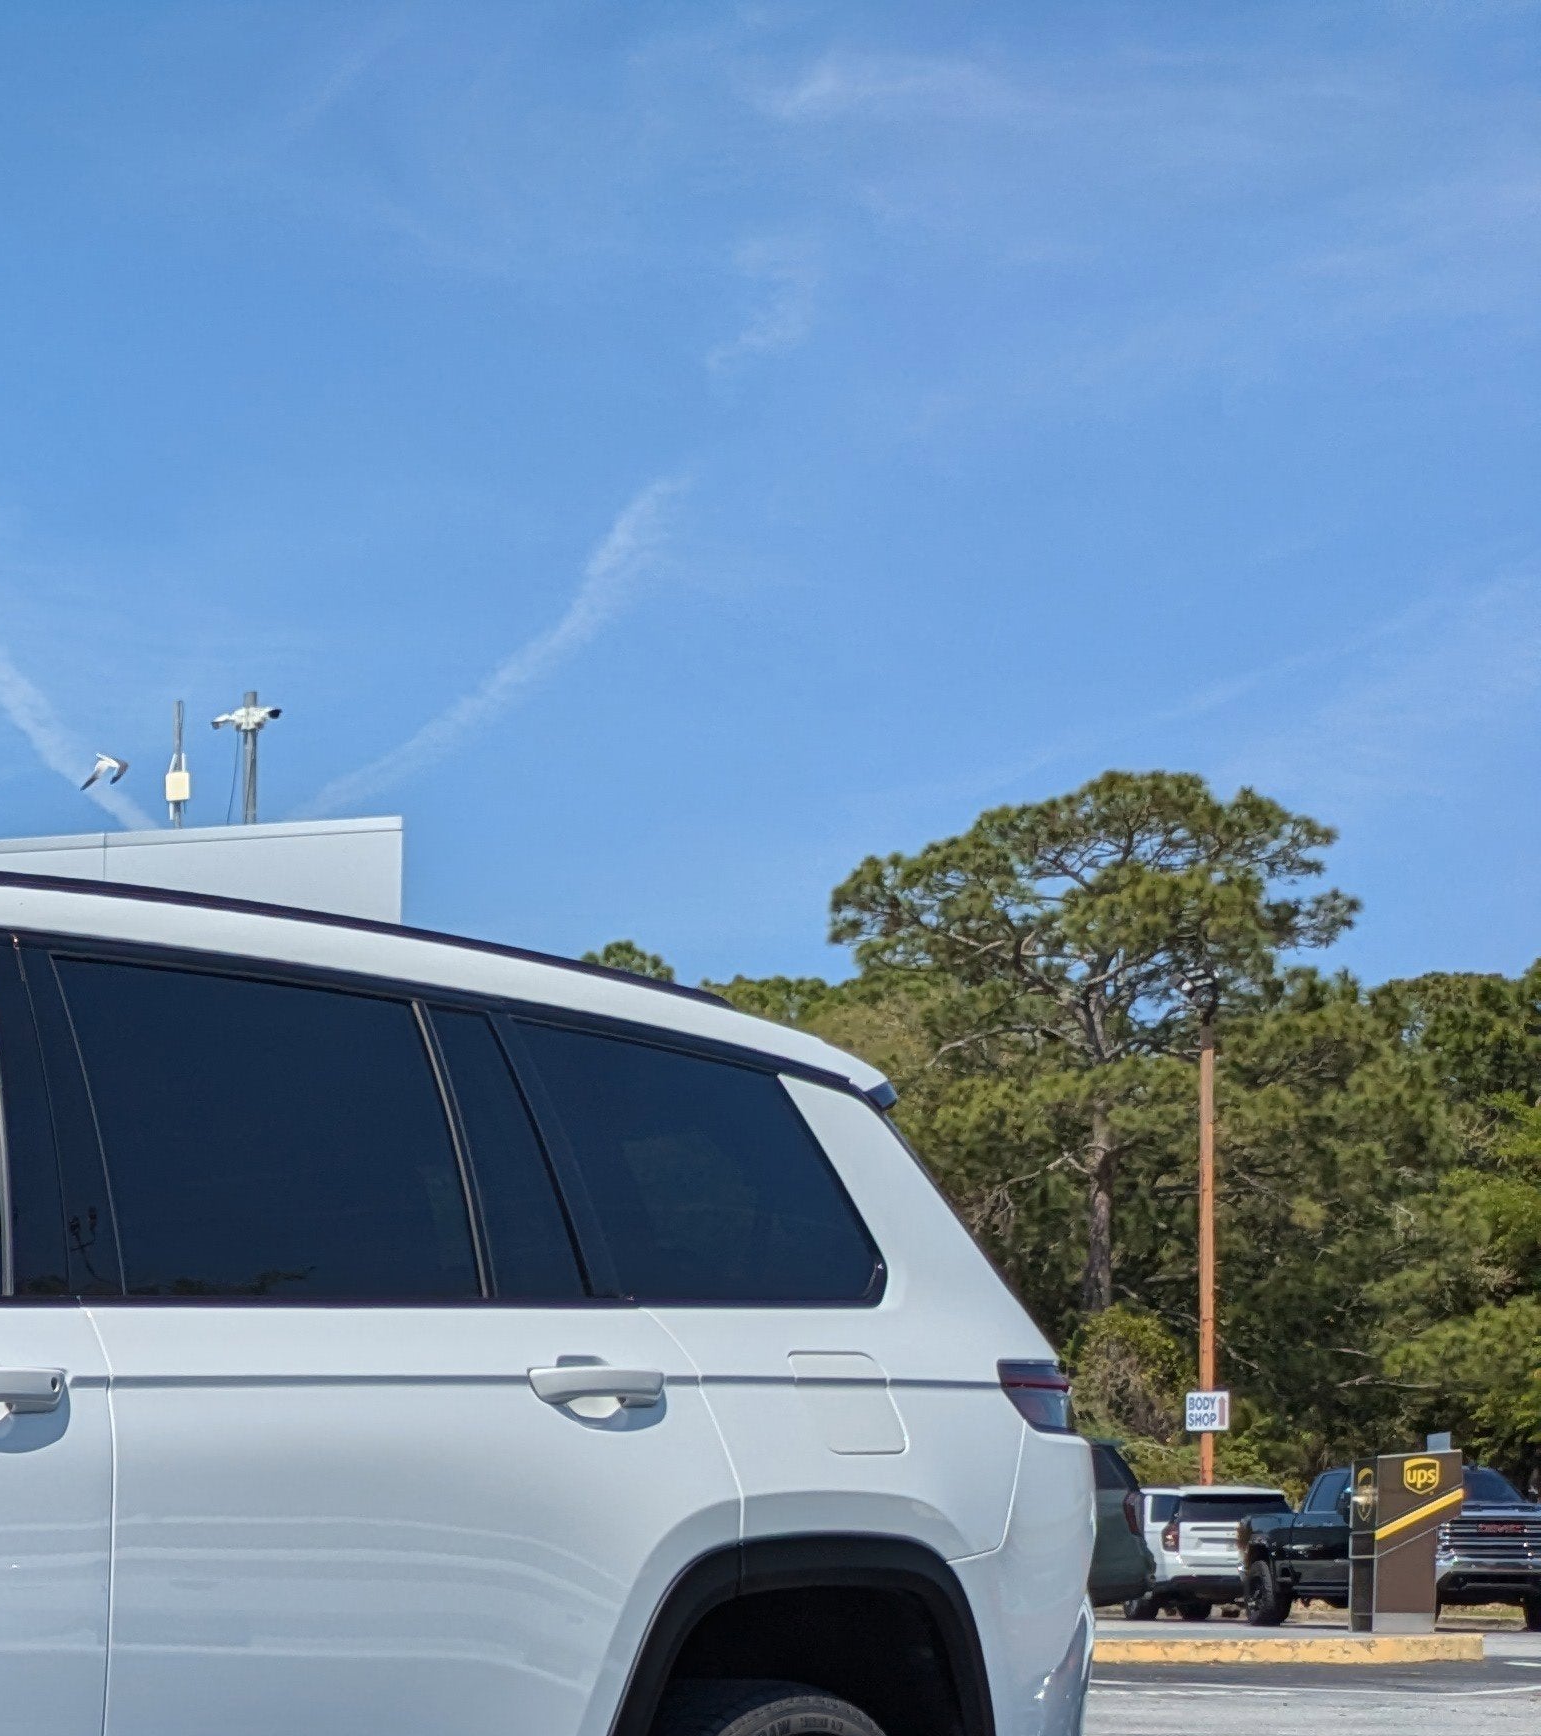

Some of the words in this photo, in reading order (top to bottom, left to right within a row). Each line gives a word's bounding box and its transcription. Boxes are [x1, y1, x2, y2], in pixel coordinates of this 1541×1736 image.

[1188, 1396, 1216, 1410] BODY
[1188, 1412, 1217, 1427] SHOP
[1406, 1468, 1436, 1489] ups
